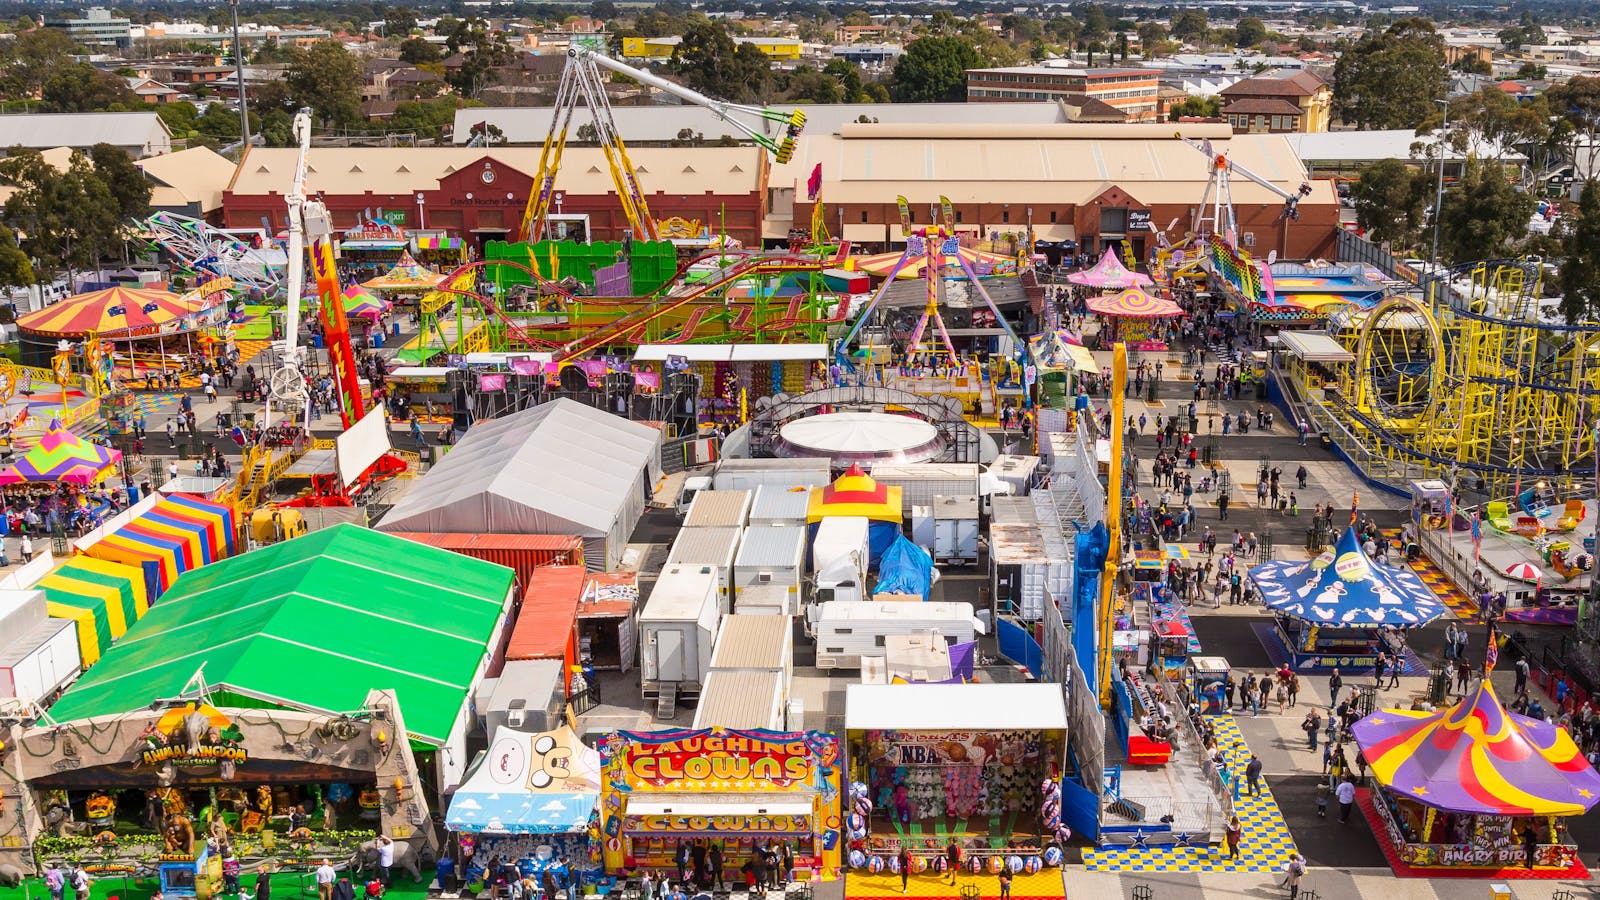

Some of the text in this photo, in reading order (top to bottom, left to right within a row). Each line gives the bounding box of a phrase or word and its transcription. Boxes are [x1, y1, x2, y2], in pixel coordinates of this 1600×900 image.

[450, 198, 472, 206] David
[474, 198, 500, 206] Roche
[143, 744, 187, 764] ANIMAL
[633, 737, 807, 756] LAUGHING
[901, 745, 938, 764] NBA
[632, 756, 809, 780] CLOWNS
[647, 815, 789, 831] CLOWNS
[1475, 835, 1511, 849] THEY WIN
[159, 854, 195, 862] TICKETS
[1443, 849, 1541, 863] ANGRY BIRS
